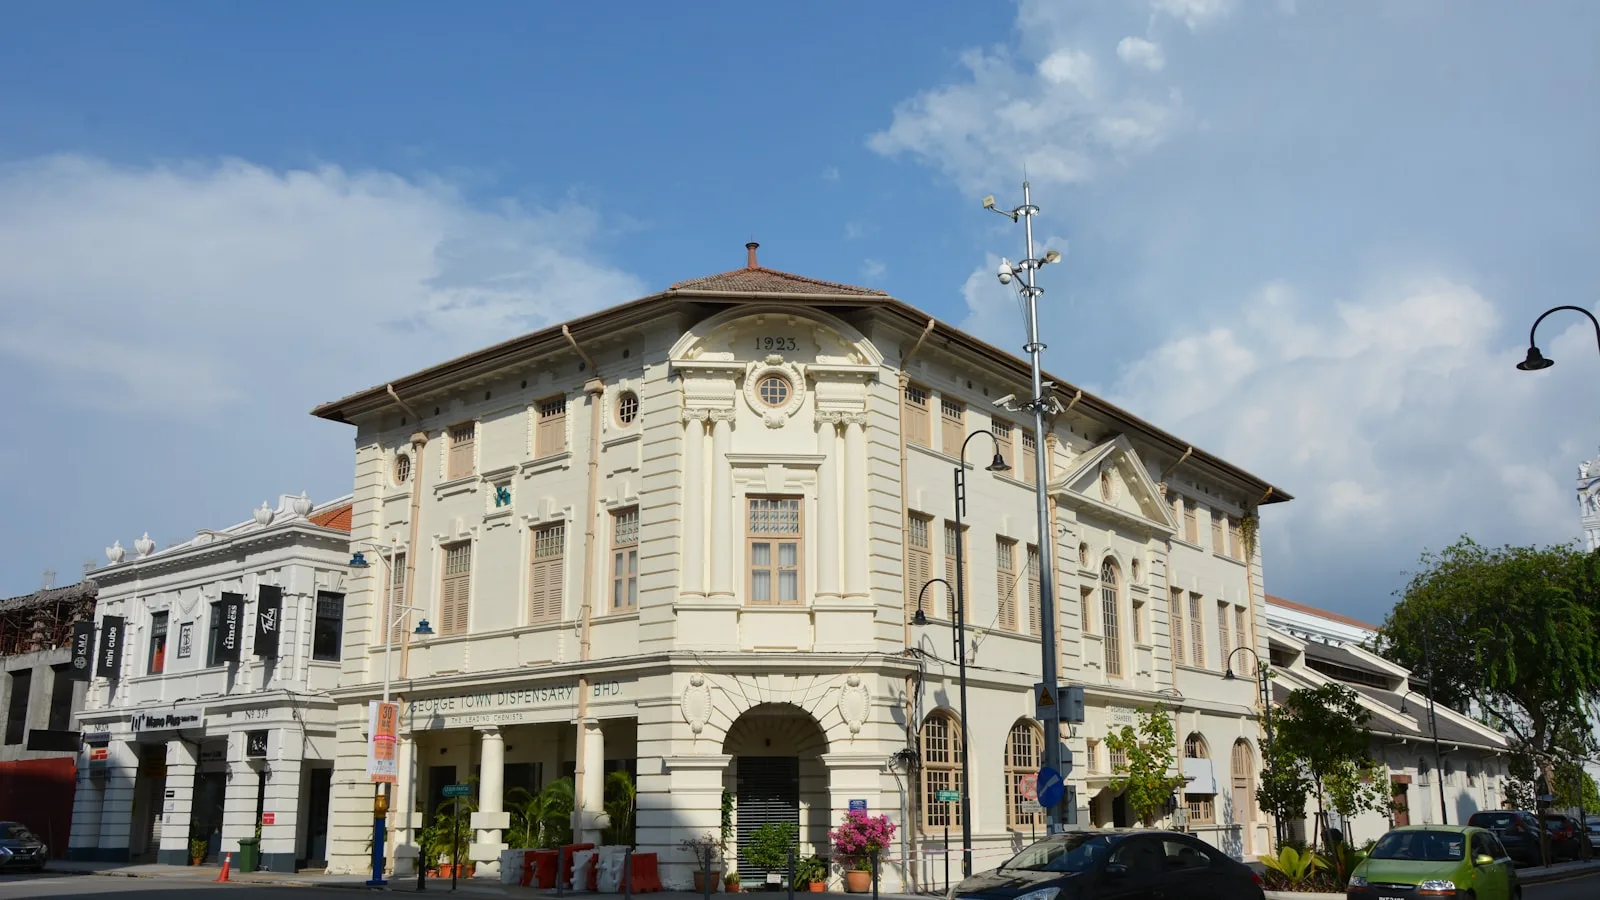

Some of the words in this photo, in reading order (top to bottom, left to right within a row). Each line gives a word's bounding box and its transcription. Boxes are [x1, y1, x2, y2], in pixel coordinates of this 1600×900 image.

[756, 336, 800, 351] 1923.
[108, 626, 117, 648] cube
[223, 604, 238, 650] timeless
[78, 633, 87, 655] KMA
[105, 648, 114, 668] mini
[410, 696, 455, 713] GEORGE
[460, 691, 492, 708] TOWN
[498, 685, 574, 706] DISPENSARY
[593, 681, 623, 697] BHD.
[165, 714, 181, 727] Plus
[382, 706, 393, 719] 30
[465, 715, 489, 723] LEADING
[494, 713, 523, 721] CHEMISTS
